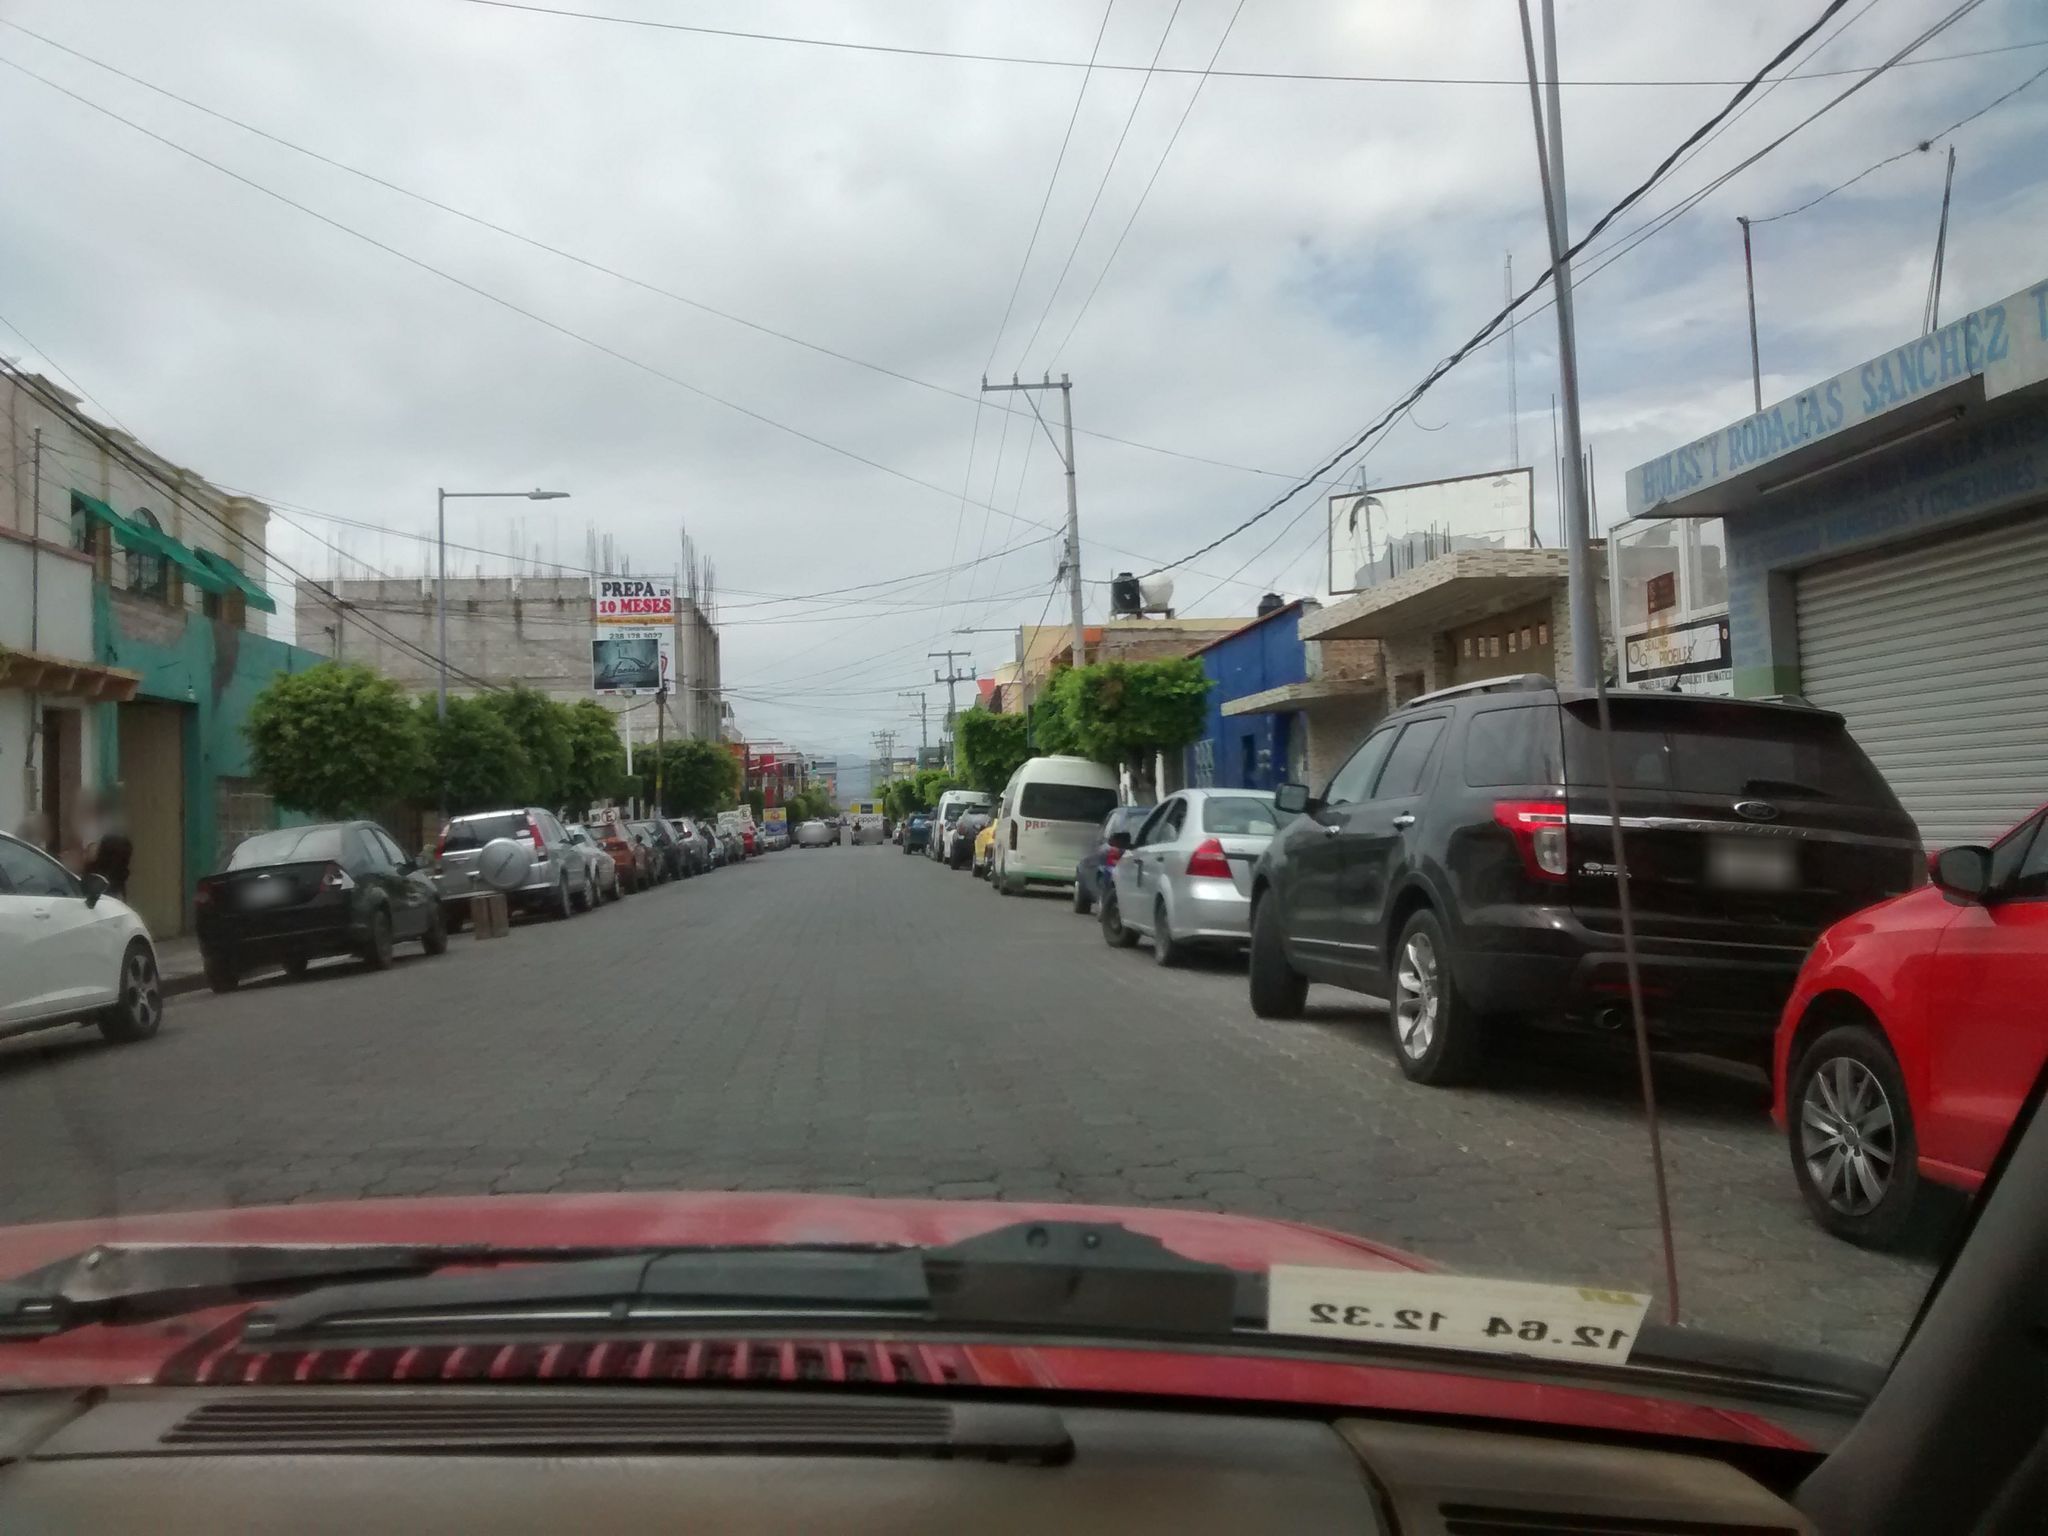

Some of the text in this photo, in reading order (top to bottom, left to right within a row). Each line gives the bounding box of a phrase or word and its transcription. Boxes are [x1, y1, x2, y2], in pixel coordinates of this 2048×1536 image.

[1642, 442, 1703, 504] HULES
[1706, 436, 1720, 478] Y
[1727, 379, 1844, 471] RODAJAS
[1861, 305, 2009, 414] SANCHEZ
[601, 581, 671, 597] PREPA EN
[600, 598, 671, 613] 10 MESES
